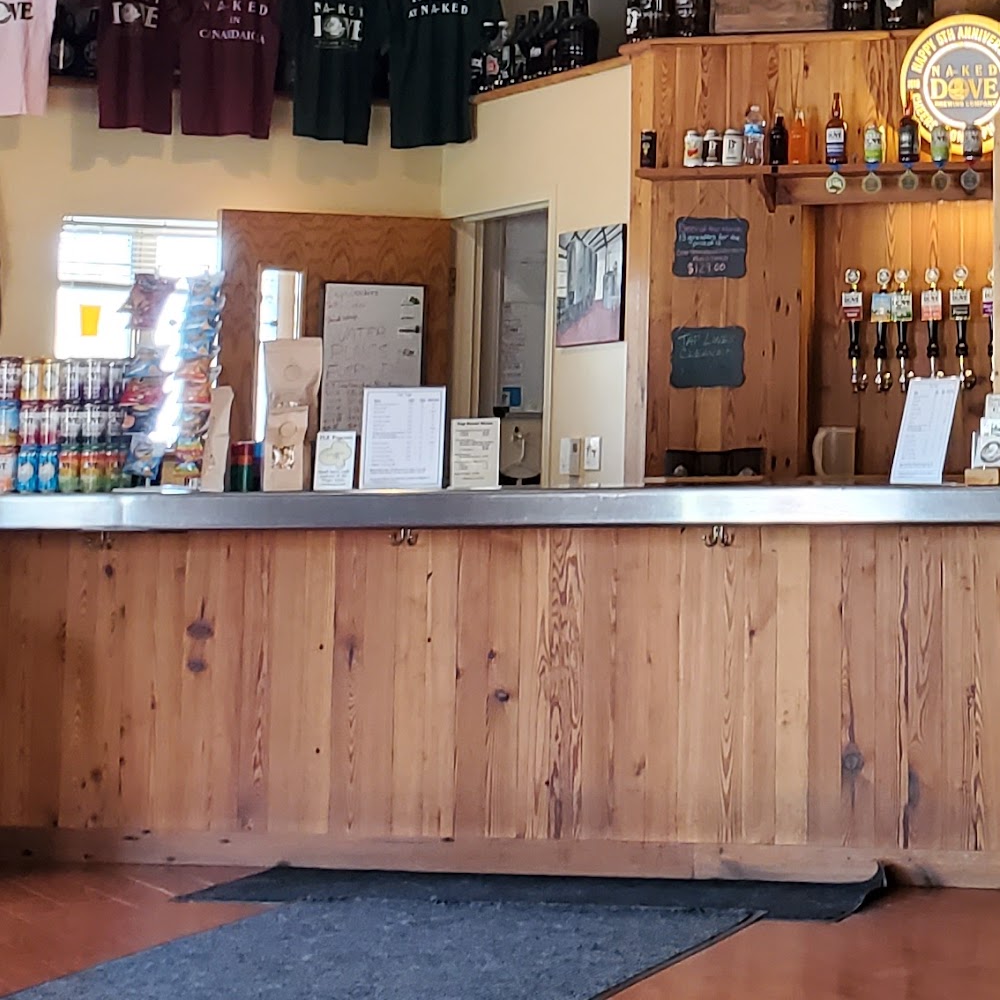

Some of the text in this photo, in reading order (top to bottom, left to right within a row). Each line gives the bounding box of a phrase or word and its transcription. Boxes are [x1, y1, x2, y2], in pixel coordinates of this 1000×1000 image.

[420, 2, 469, 15] NAKED
[910, 38, 937, 74] HAPPY
[931, 63, 999, 78] NAKED
[930, 77, 1000, 100] DOVE
